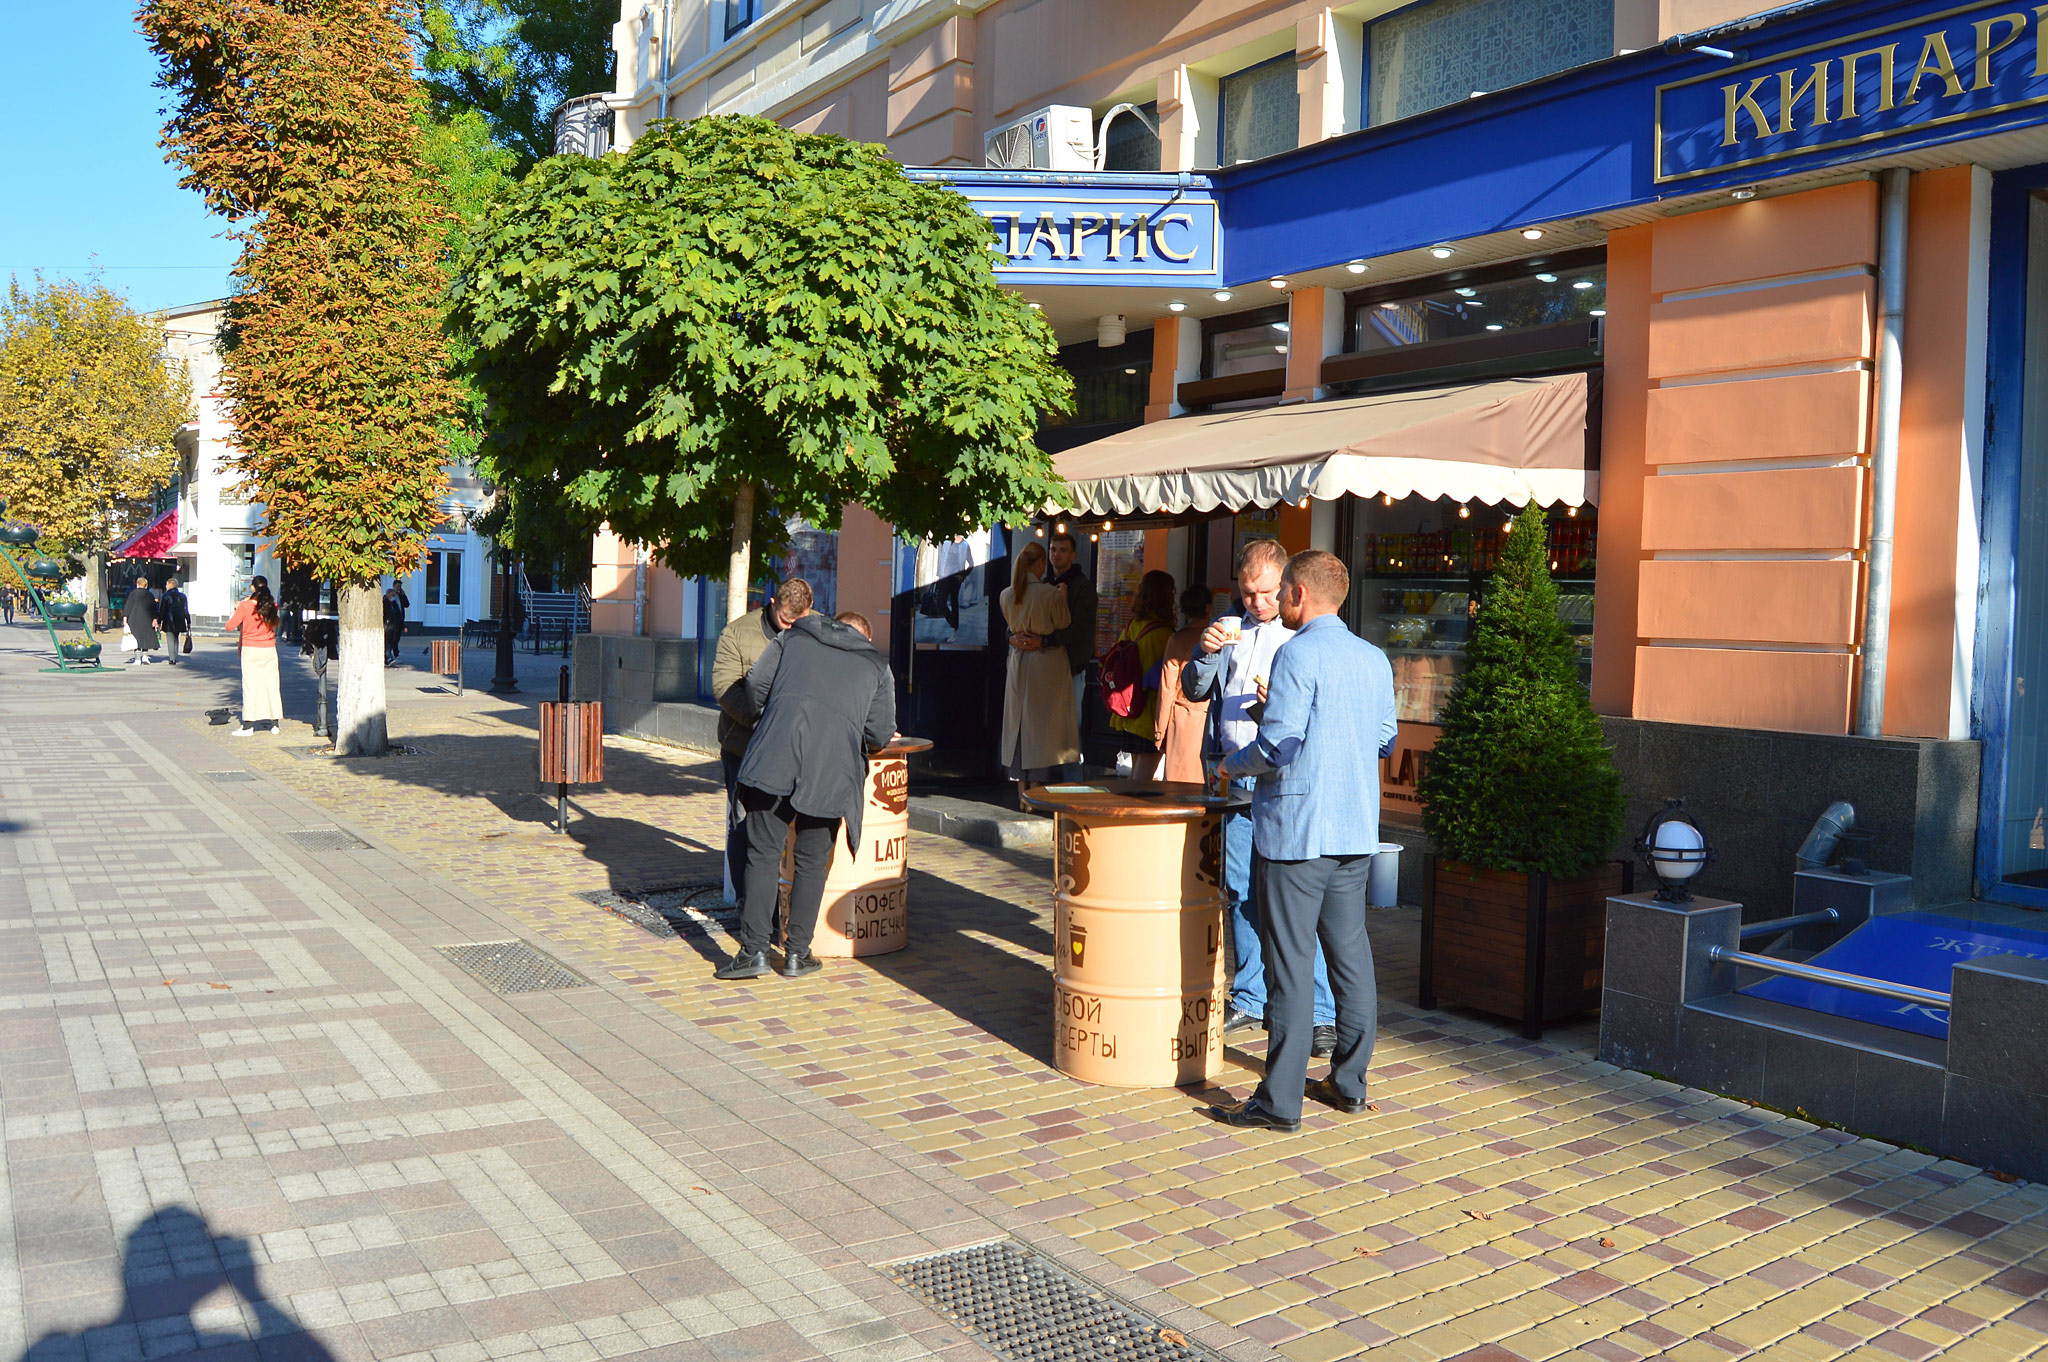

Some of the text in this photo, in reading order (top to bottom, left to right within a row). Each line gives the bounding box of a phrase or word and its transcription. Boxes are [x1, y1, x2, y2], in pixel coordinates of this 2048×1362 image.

[881, 768, 908, 788] МОРО
[1383, 791, 1407, 801] COFFEE
[875, 835, 908, 863] LATT
[855, 892, 896, 915] КОФЕ
[1183, 990, 1221, 1026] КОФЕ
